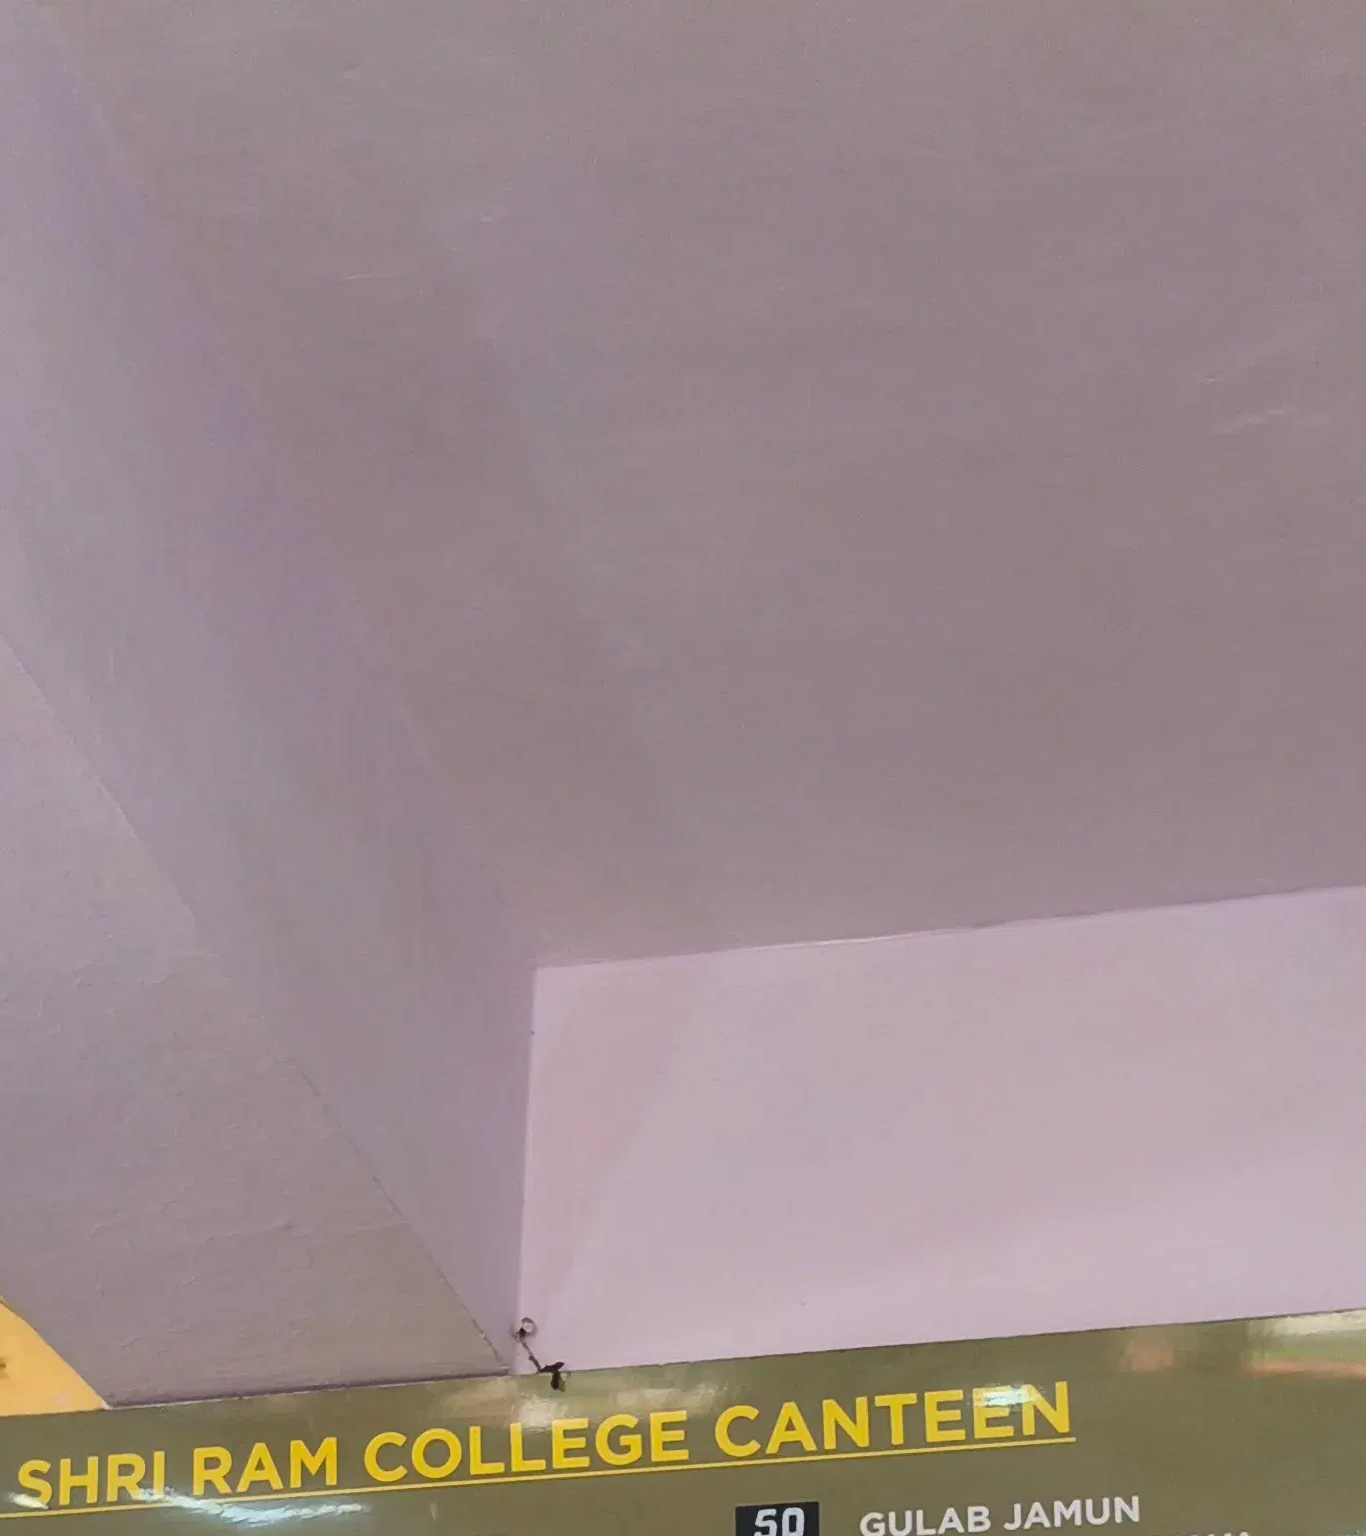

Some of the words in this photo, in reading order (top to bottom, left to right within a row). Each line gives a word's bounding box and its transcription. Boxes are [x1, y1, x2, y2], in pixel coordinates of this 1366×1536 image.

[17, 1450, 166, 1507] SHRI
[193, 1436, 338, 1496] RAM
[362, 1409, 691, 1483] COLLEGE
[713, 1380, 1072, 1457] CANTEEN
[1002, 1495, 1140, 1531] JAMUN
